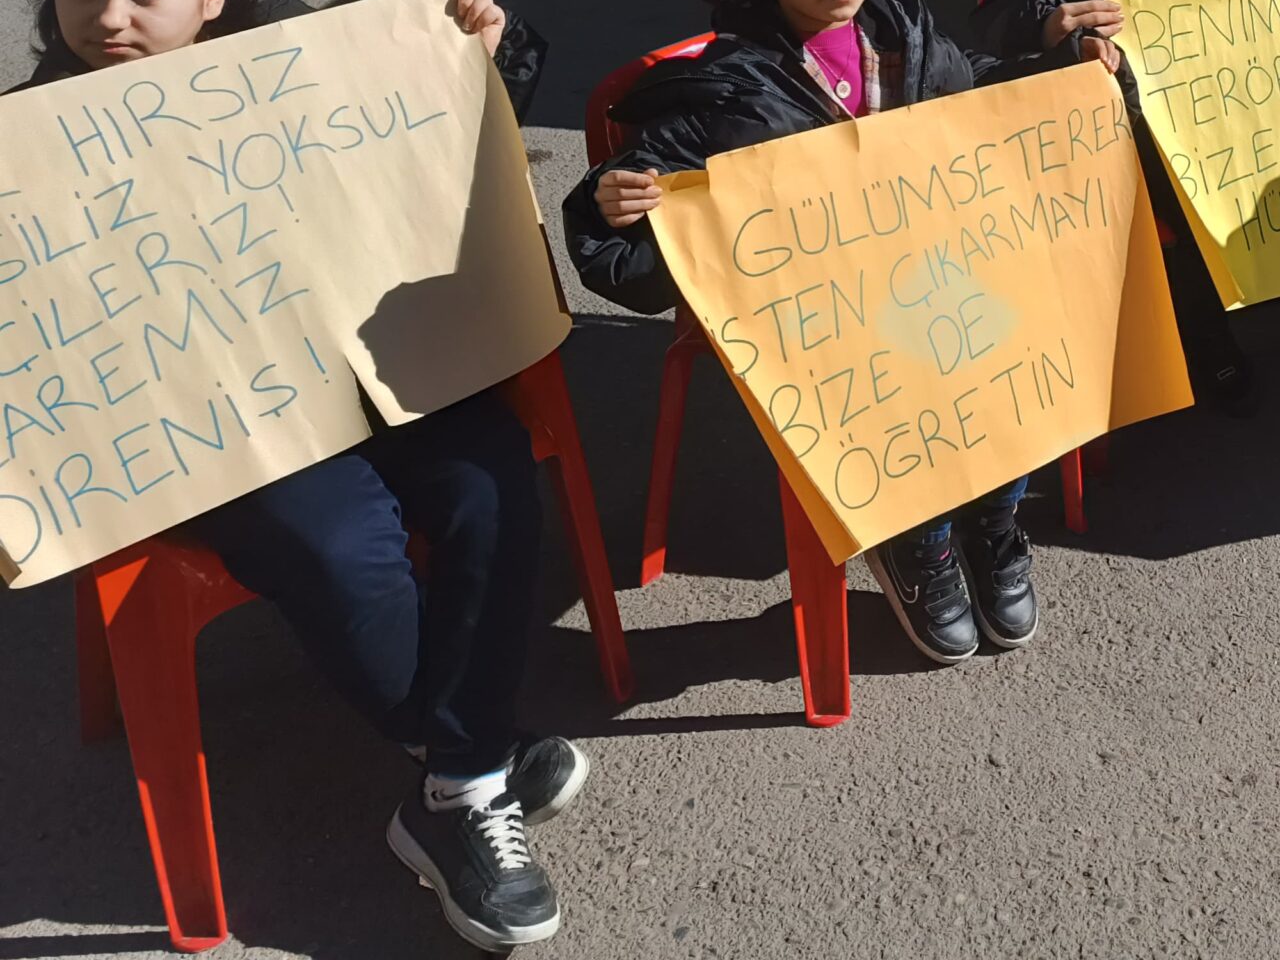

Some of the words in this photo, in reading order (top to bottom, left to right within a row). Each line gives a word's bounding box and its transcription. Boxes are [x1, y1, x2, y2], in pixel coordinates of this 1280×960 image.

[57, 47, 320, 176] HIRSIZ
[187, 90, 447, 195] YOKSUL
[1169, 128, 1278, 201] BİZE
[769, 350, 902, 460] BİZE
[927, 293, 995, 376] DE
[835, 337, 1075, 510] ÖĞRETİN
